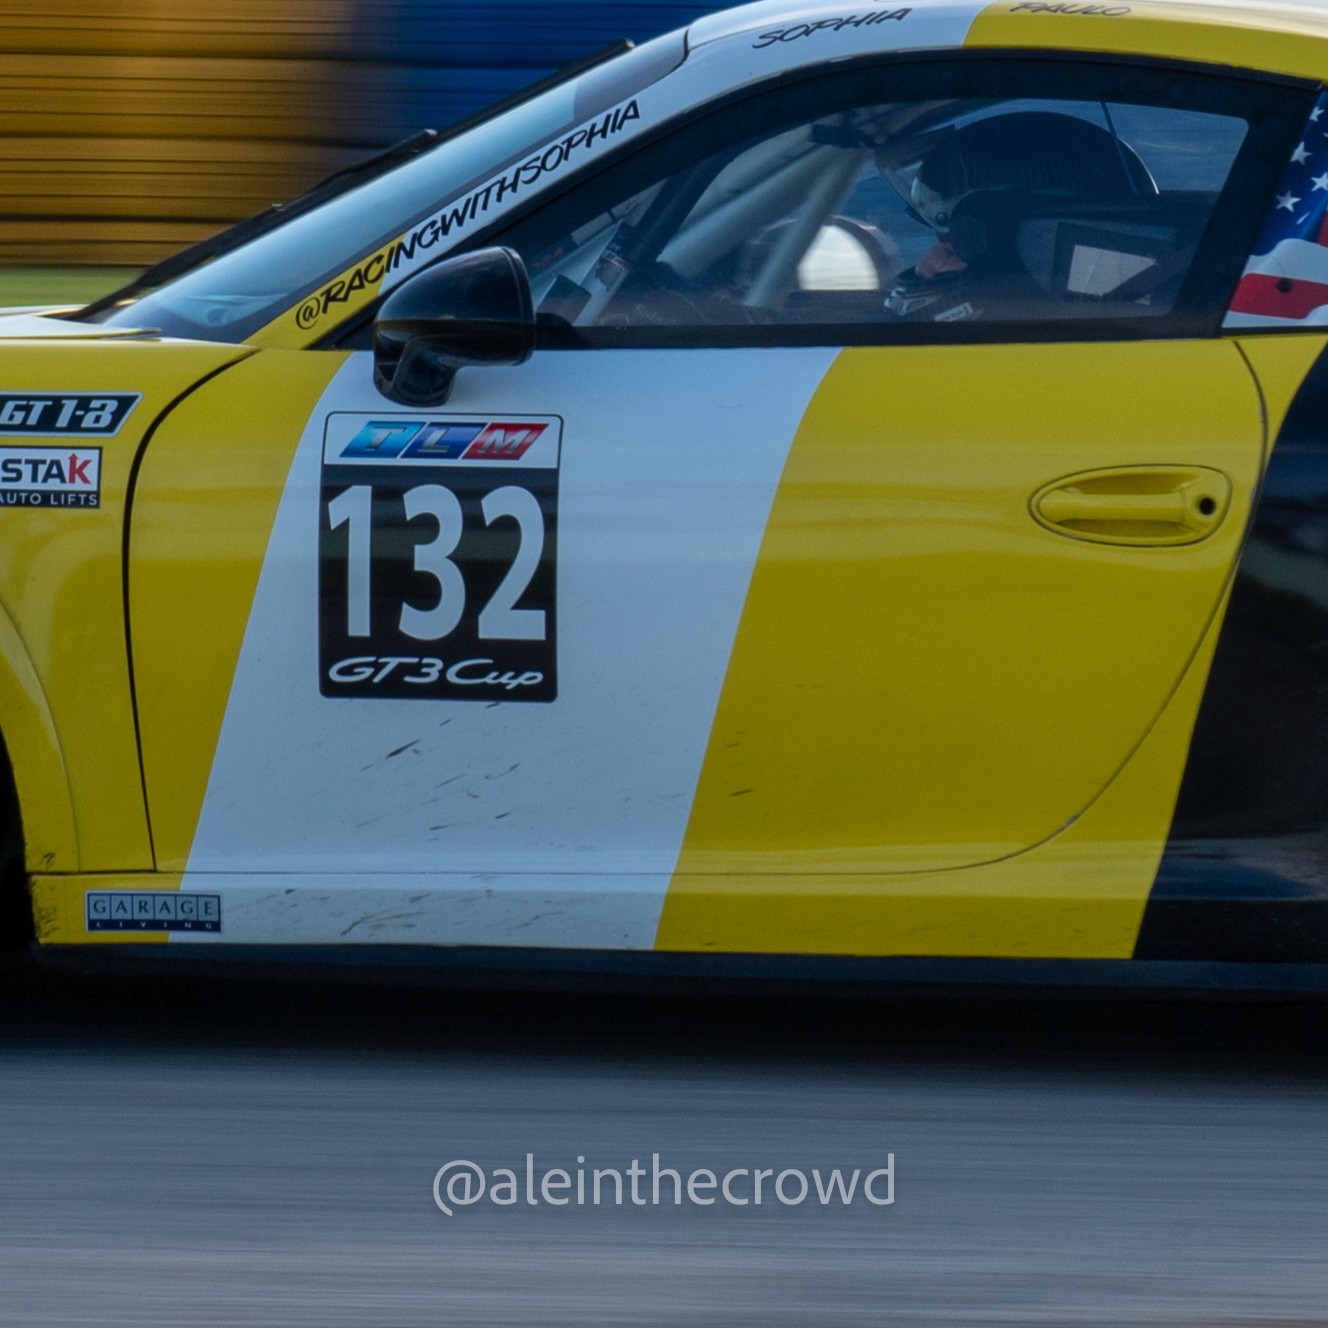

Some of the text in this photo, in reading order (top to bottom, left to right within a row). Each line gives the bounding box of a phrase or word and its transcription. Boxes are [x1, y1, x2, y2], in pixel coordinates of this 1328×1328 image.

[1009, 1, 1132, 18] PAULO
[752, 7, 914, 50] SOPHIA
[295, 99, 641, 330] @RACINGWITHSOPHIA
[365, 425, 533, 455] TLM
[0, 452, 93, 485] STAK
[49, 492, 98, 507] LIFTS
[327, 483, 547, 642] 132
[93, 899, 213, 916] GARAGE
